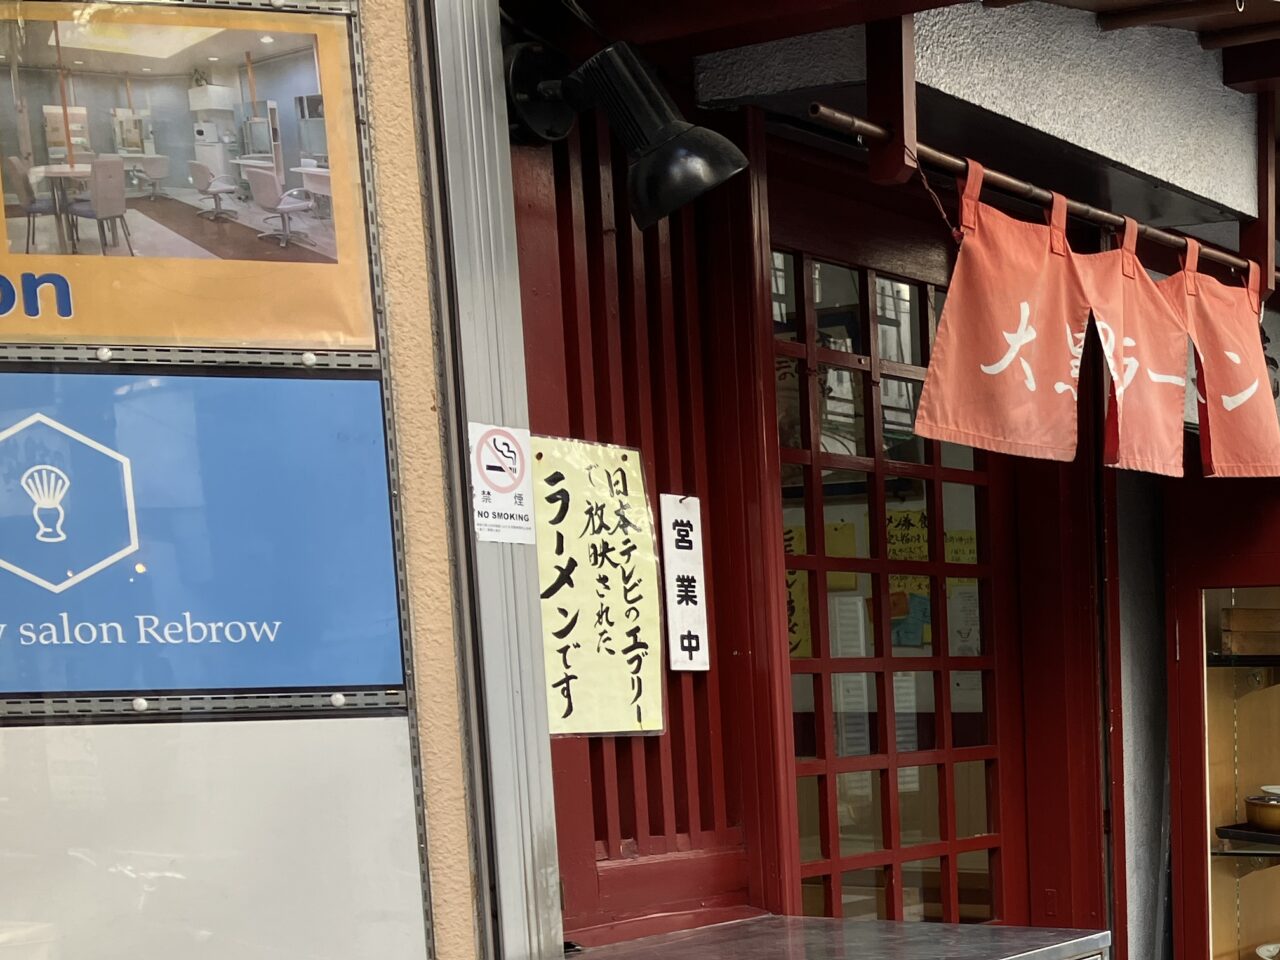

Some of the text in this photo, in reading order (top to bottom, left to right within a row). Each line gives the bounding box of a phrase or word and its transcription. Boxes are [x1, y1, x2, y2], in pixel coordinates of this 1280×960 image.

[477, 510, 530, 522] NO SMOKING
[20, 612, 127, 645] salon
[136, 611, 283, 645] Rebrow
[540, 470, 581, 719] ラーメンです
[672, 518, 701, 661] 営業中
